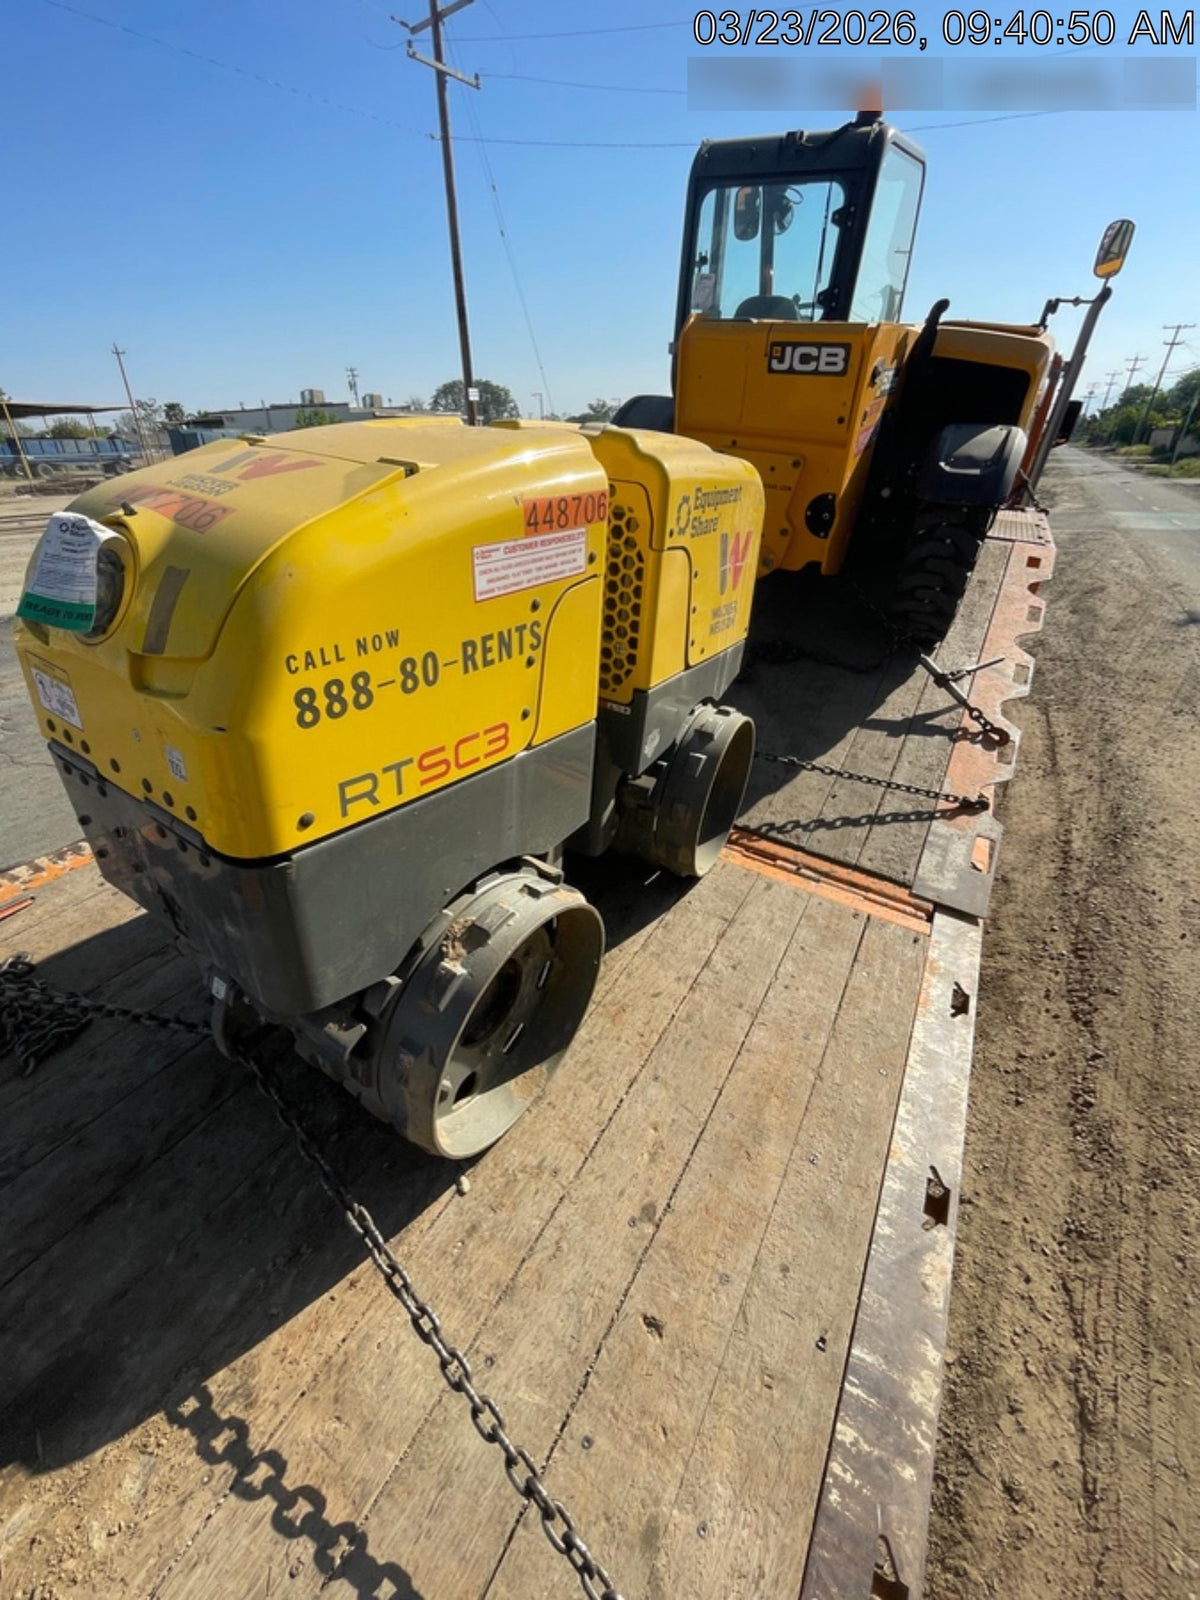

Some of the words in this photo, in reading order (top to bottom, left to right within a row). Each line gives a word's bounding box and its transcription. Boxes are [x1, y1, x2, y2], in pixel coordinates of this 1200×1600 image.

[770, 345, 847, 372] JCB
[526, 492, 608, 533] 448706
[693, 485, 743, 514] Equipment
[690, 515, 720, 538] Share
[25, 600, 61, 618] READY
[285, 644, 346, 675] CALL
[355, 628, 400, 657] NOW
[337, 721, 510, 819] RTSC3
